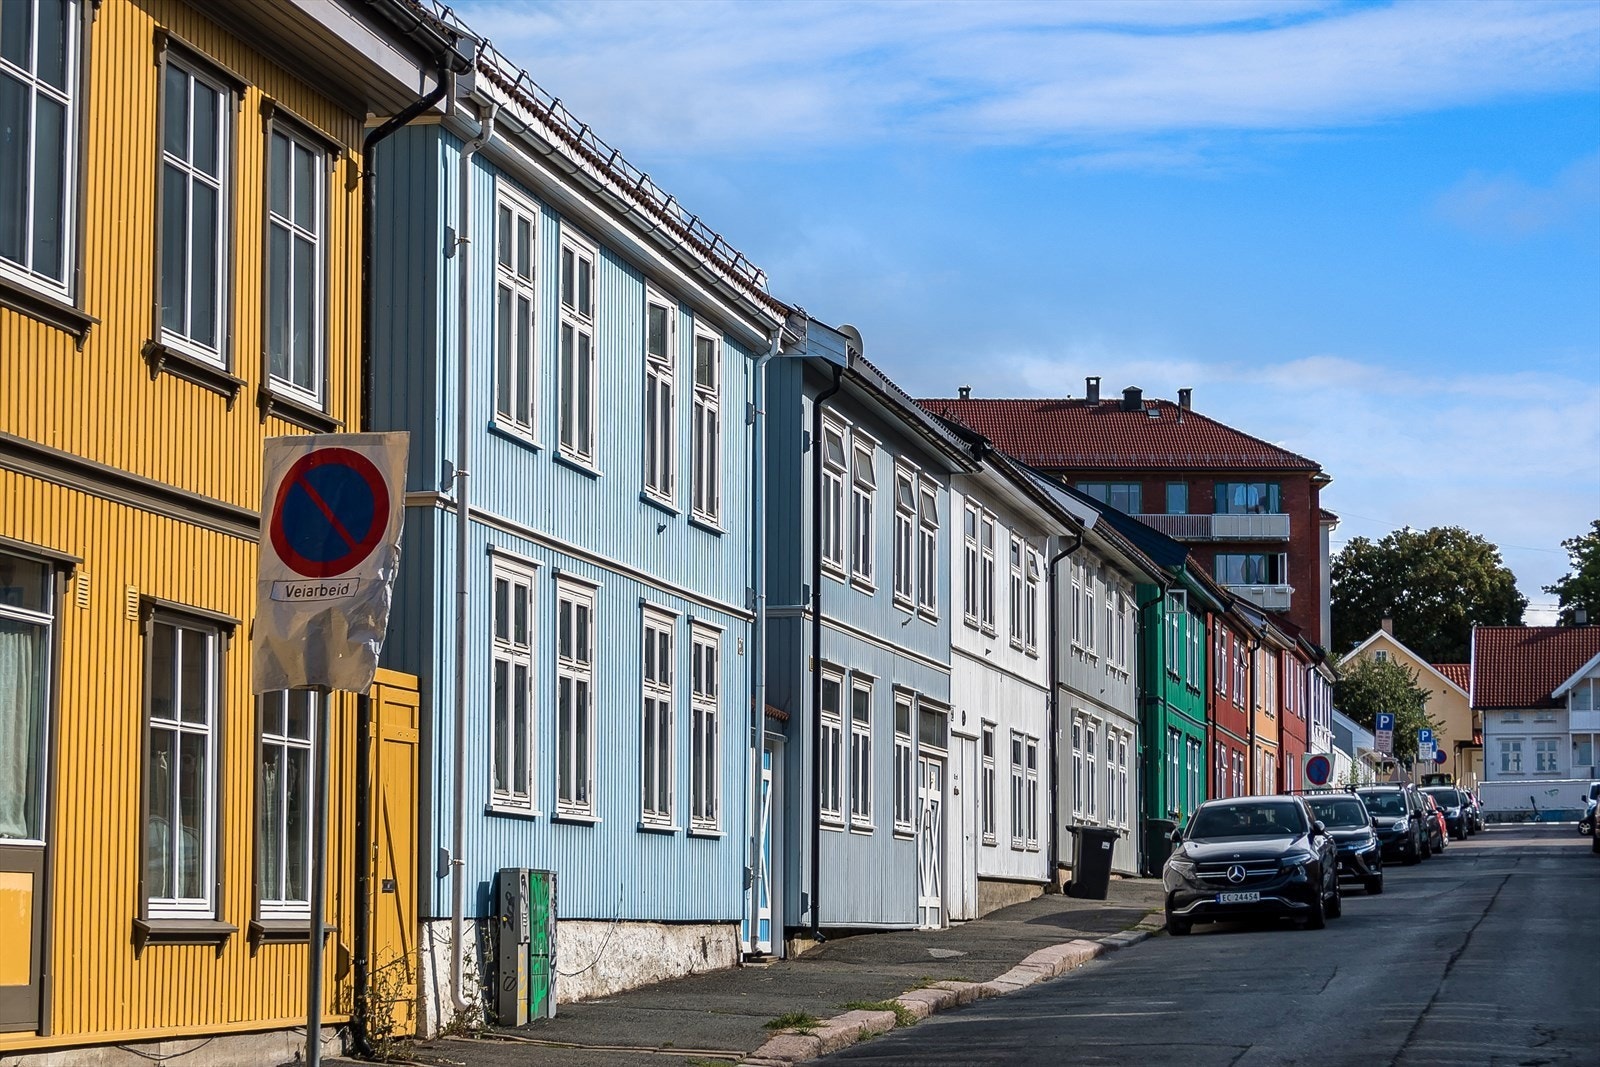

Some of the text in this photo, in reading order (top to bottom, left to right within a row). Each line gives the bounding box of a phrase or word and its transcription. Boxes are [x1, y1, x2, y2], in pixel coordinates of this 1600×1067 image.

[286, 583, 350, 598] Veiarbeid
[1380, 715, 1390, 728] P
[1421, 731, 1429, 741] P
[1222, 893, 1258, 902] EC 24454
